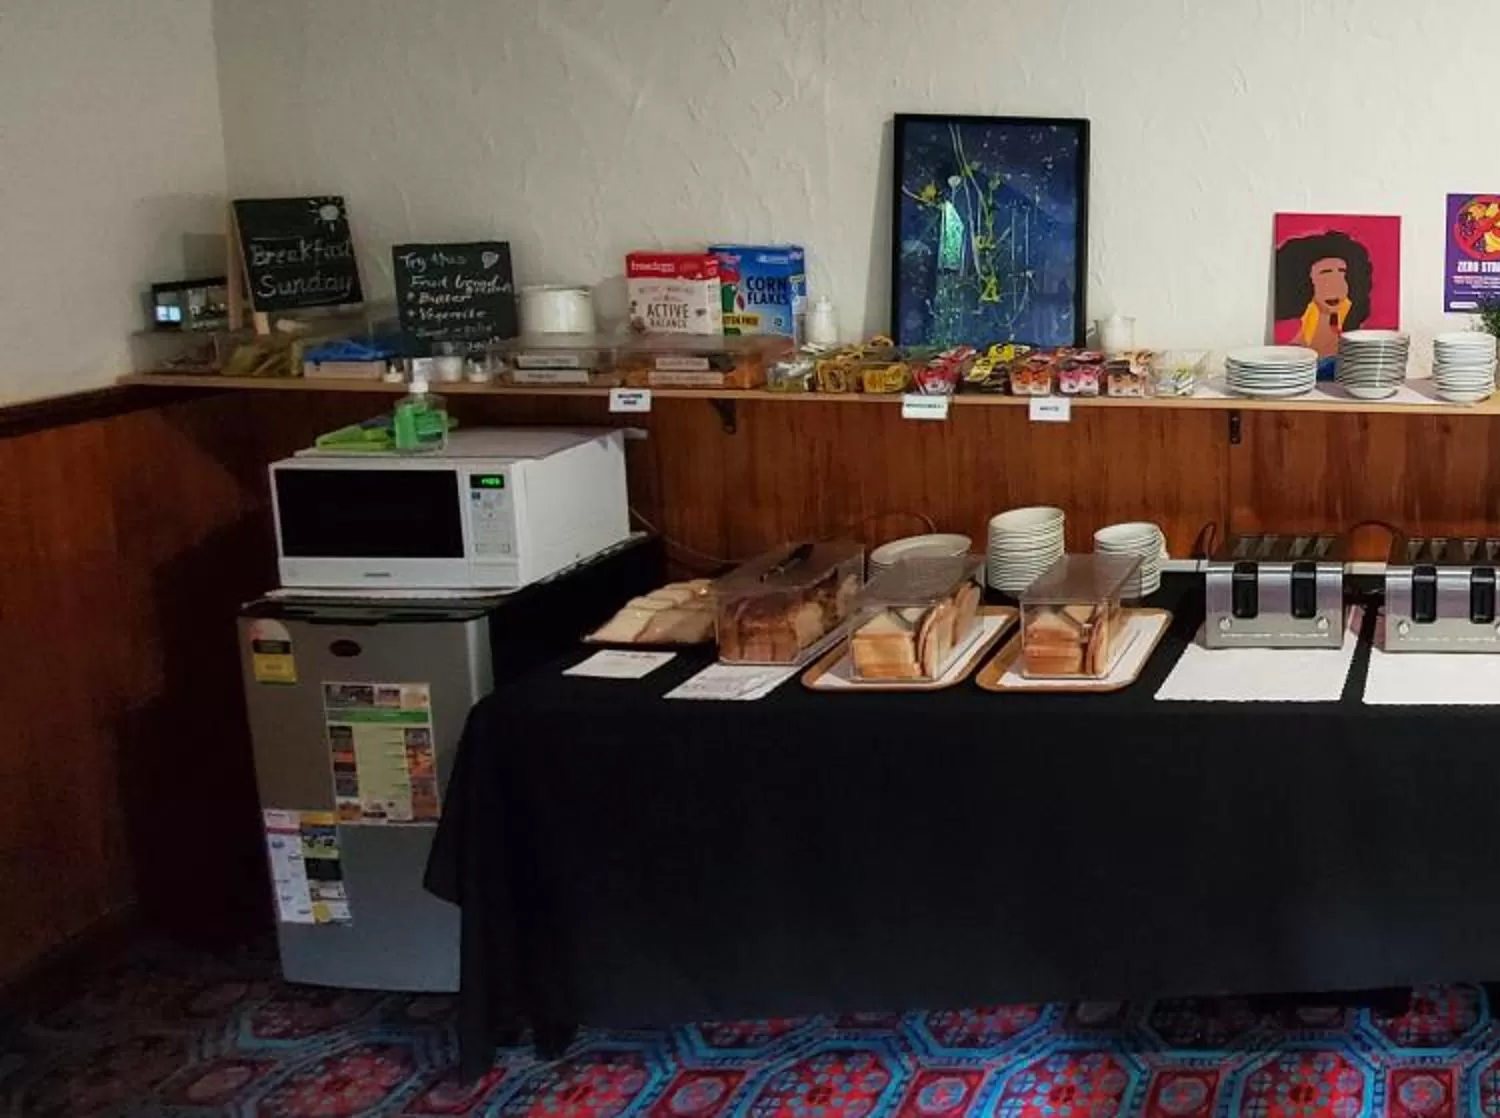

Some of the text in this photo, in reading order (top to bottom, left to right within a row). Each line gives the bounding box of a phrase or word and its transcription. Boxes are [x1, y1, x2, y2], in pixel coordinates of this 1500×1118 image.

[399, 251, 427, 272] Try
[1457, 261, 1479, 273] ZERO
[256, 271, 352, 298] Sunday
[746, 275, 788, 291] CORN
[647, 303, 690, 319] ACTIVE
